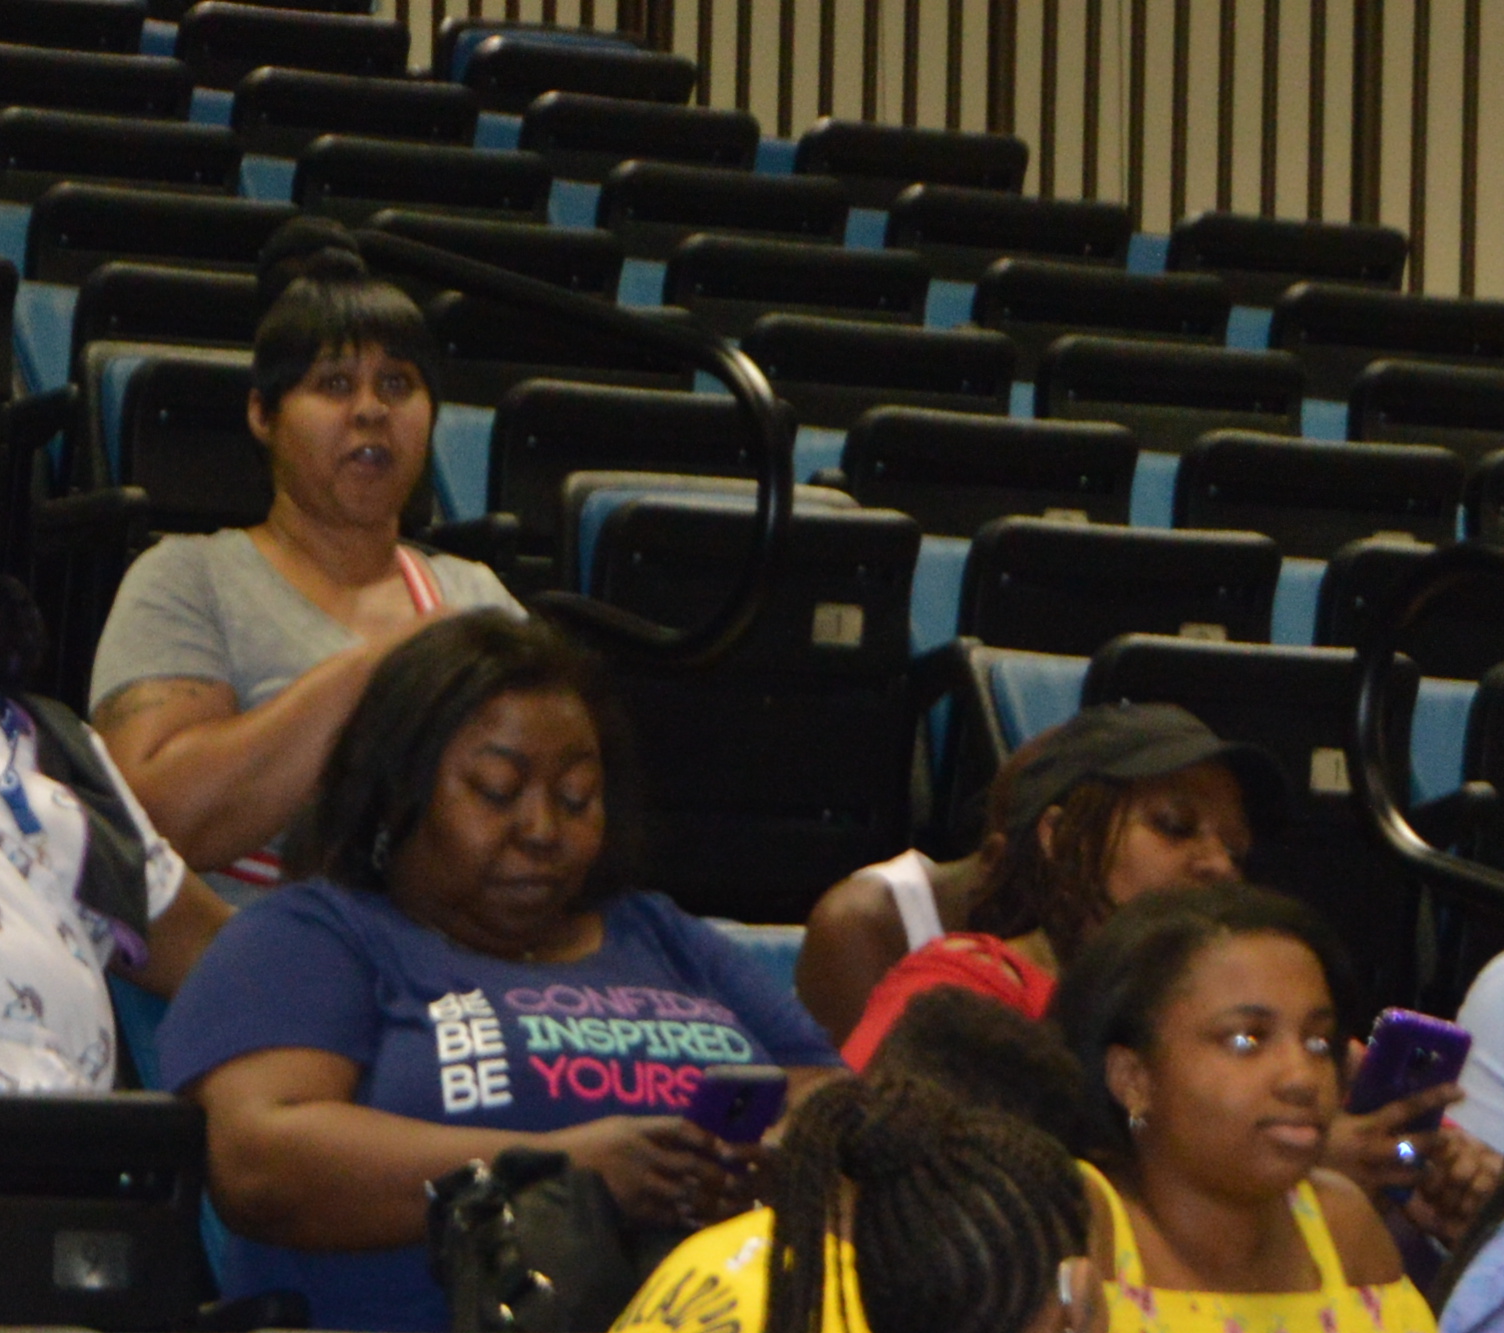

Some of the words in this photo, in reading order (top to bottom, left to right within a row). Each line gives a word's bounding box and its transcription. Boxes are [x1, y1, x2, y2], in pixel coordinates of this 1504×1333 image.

[436, 1018, 507, 1063] BE
[518, 1015, 754, 1063] INSPIRED
[441, 1058, 515, 1113] BE
